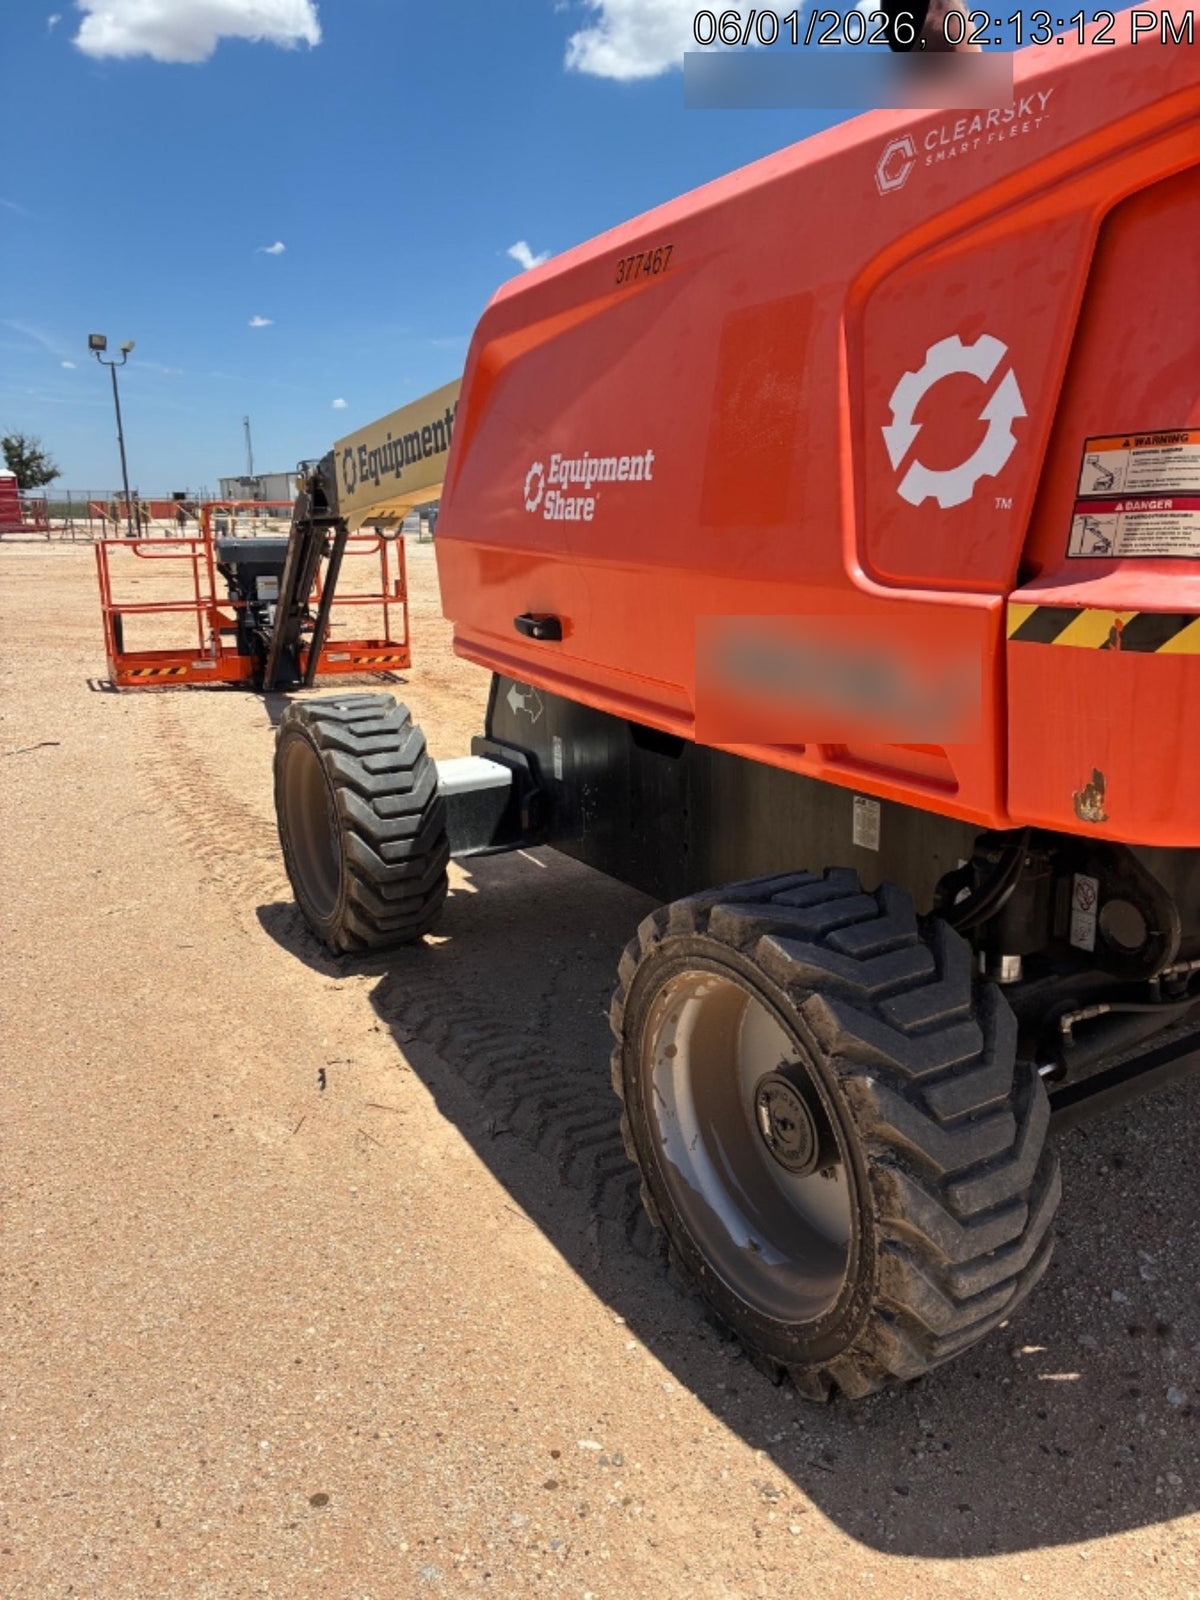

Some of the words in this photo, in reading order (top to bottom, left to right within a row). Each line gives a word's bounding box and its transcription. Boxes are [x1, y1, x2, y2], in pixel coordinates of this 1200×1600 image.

[924, 88, 1054, 150] CLEARSKY
[924, 137, 981, 167] SMART
[616, 244, 674, 285] 377467
[1134, 433, 1189, 447] WARNING
[547, 449, 655, 490] Equipment
[543, 489, 596, 522] Share
[1125, 499, 1173, 511] DANGER
